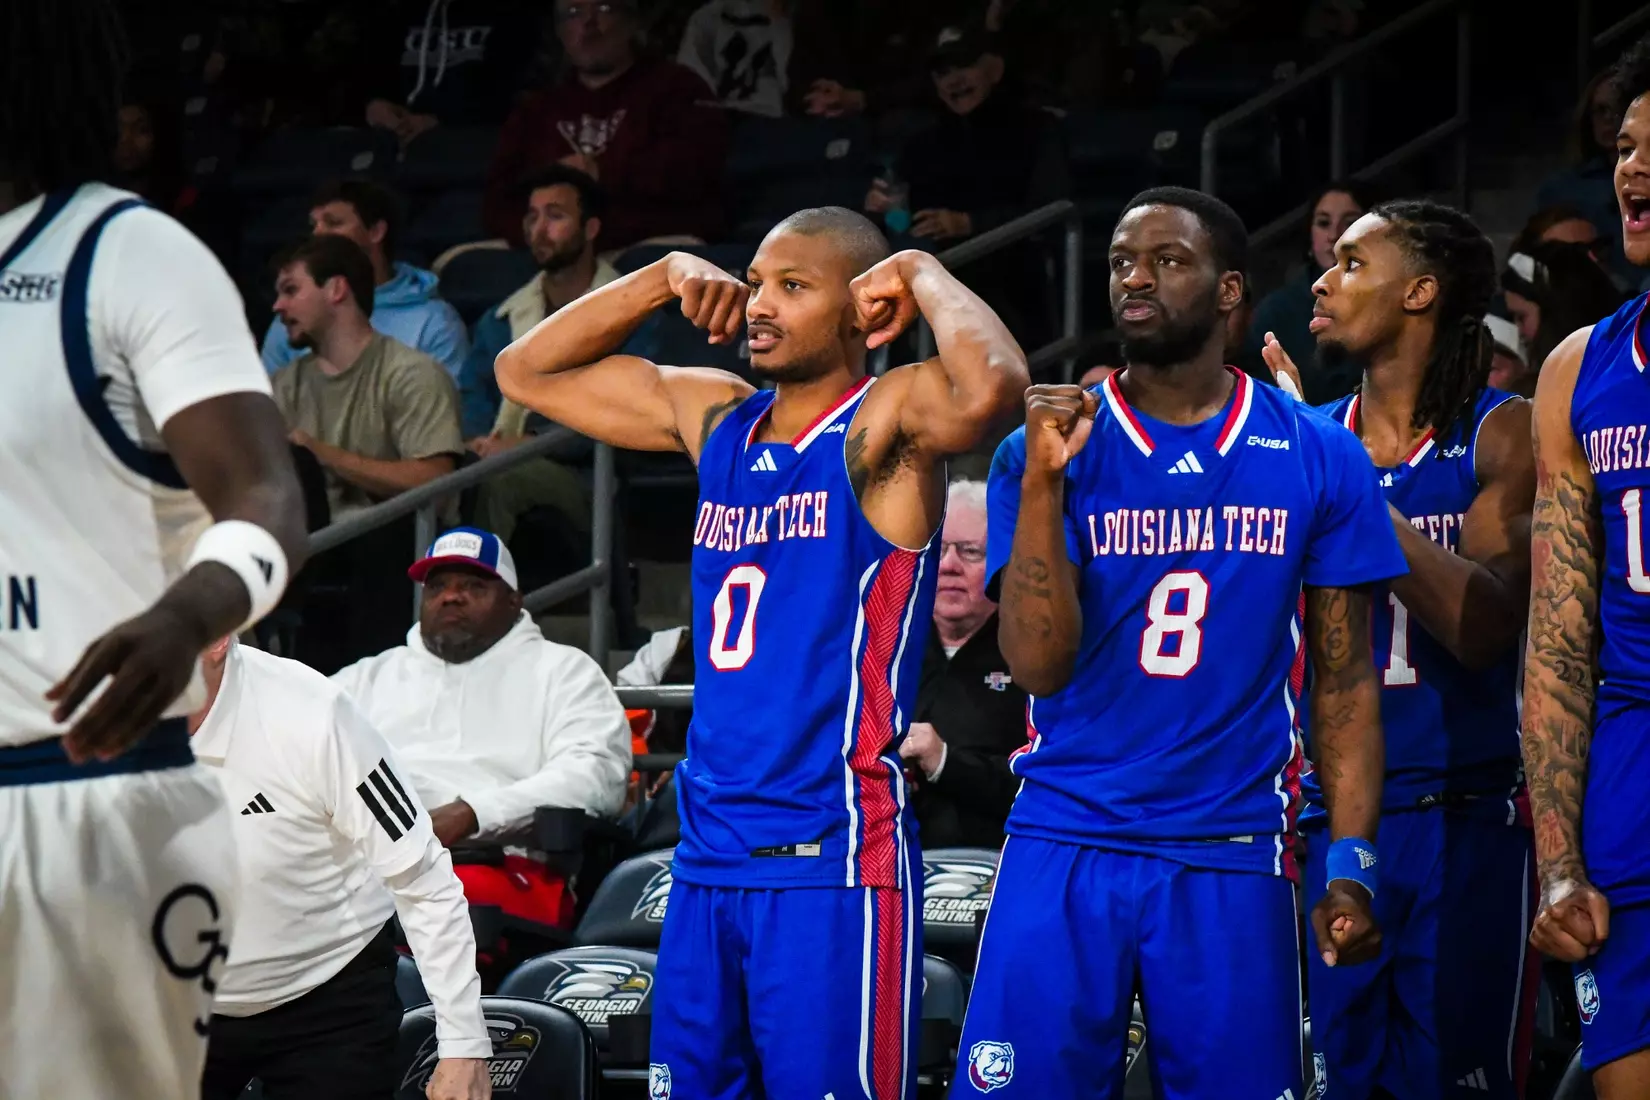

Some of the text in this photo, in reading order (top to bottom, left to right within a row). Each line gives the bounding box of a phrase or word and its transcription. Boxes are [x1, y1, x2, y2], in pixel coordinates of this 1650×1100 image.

[1582, 424, 1650, 474] LOUISI
[774, 490, 828, 541] TECH
[1223, 505, 1288, 555] TECH
[0, 574, 39, 631] N
[708, 562, 768, 672] 0
[1138, 569, 1211, 679] 8
[1383, 591, 1418, 687] 1
[562, 999, 638, 1011] GEORGIA
